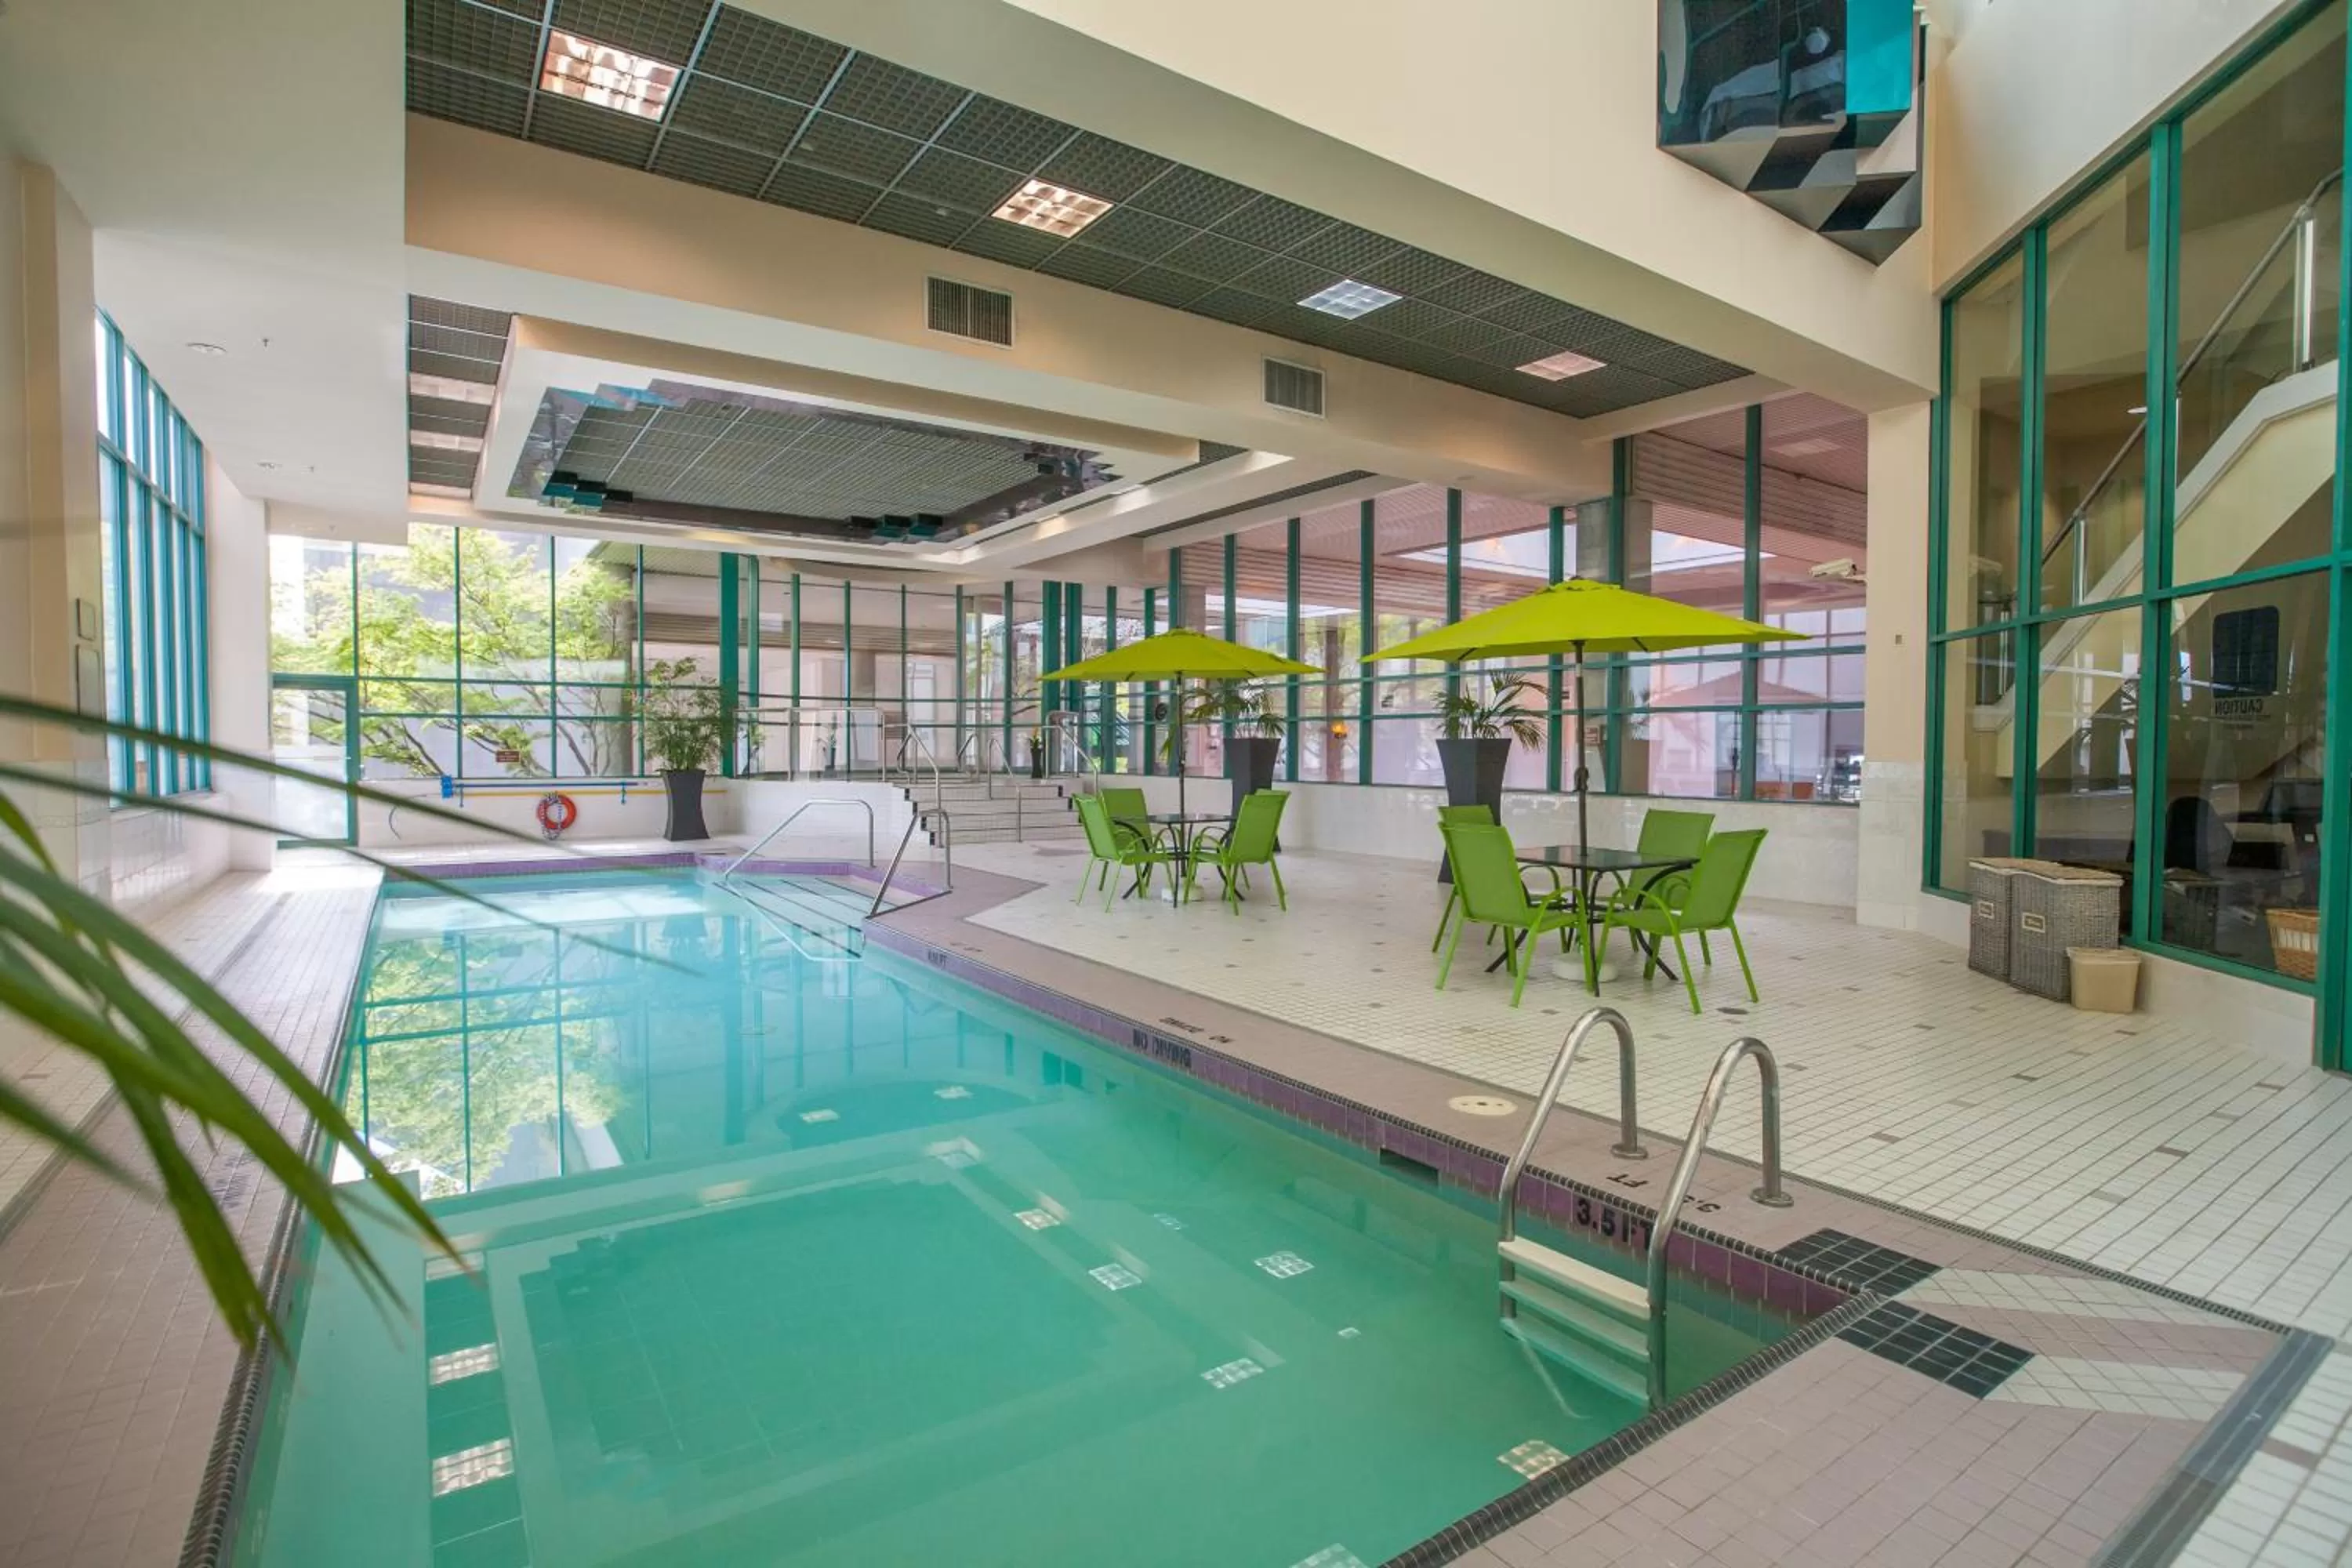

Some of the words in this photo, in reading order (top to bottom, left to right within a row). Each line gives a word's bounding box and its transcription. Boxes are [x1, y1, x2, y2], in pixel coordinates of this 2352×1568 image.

[1133, 1028, 1148, 1051] NO
[1152, 1036, 1192, 1068] DIVING
[1606, 1174, 1650, 1188] FT
[1577, 1199, 1616, 1236] 3.5
[1622, 1212, 1654, 1252] FT
